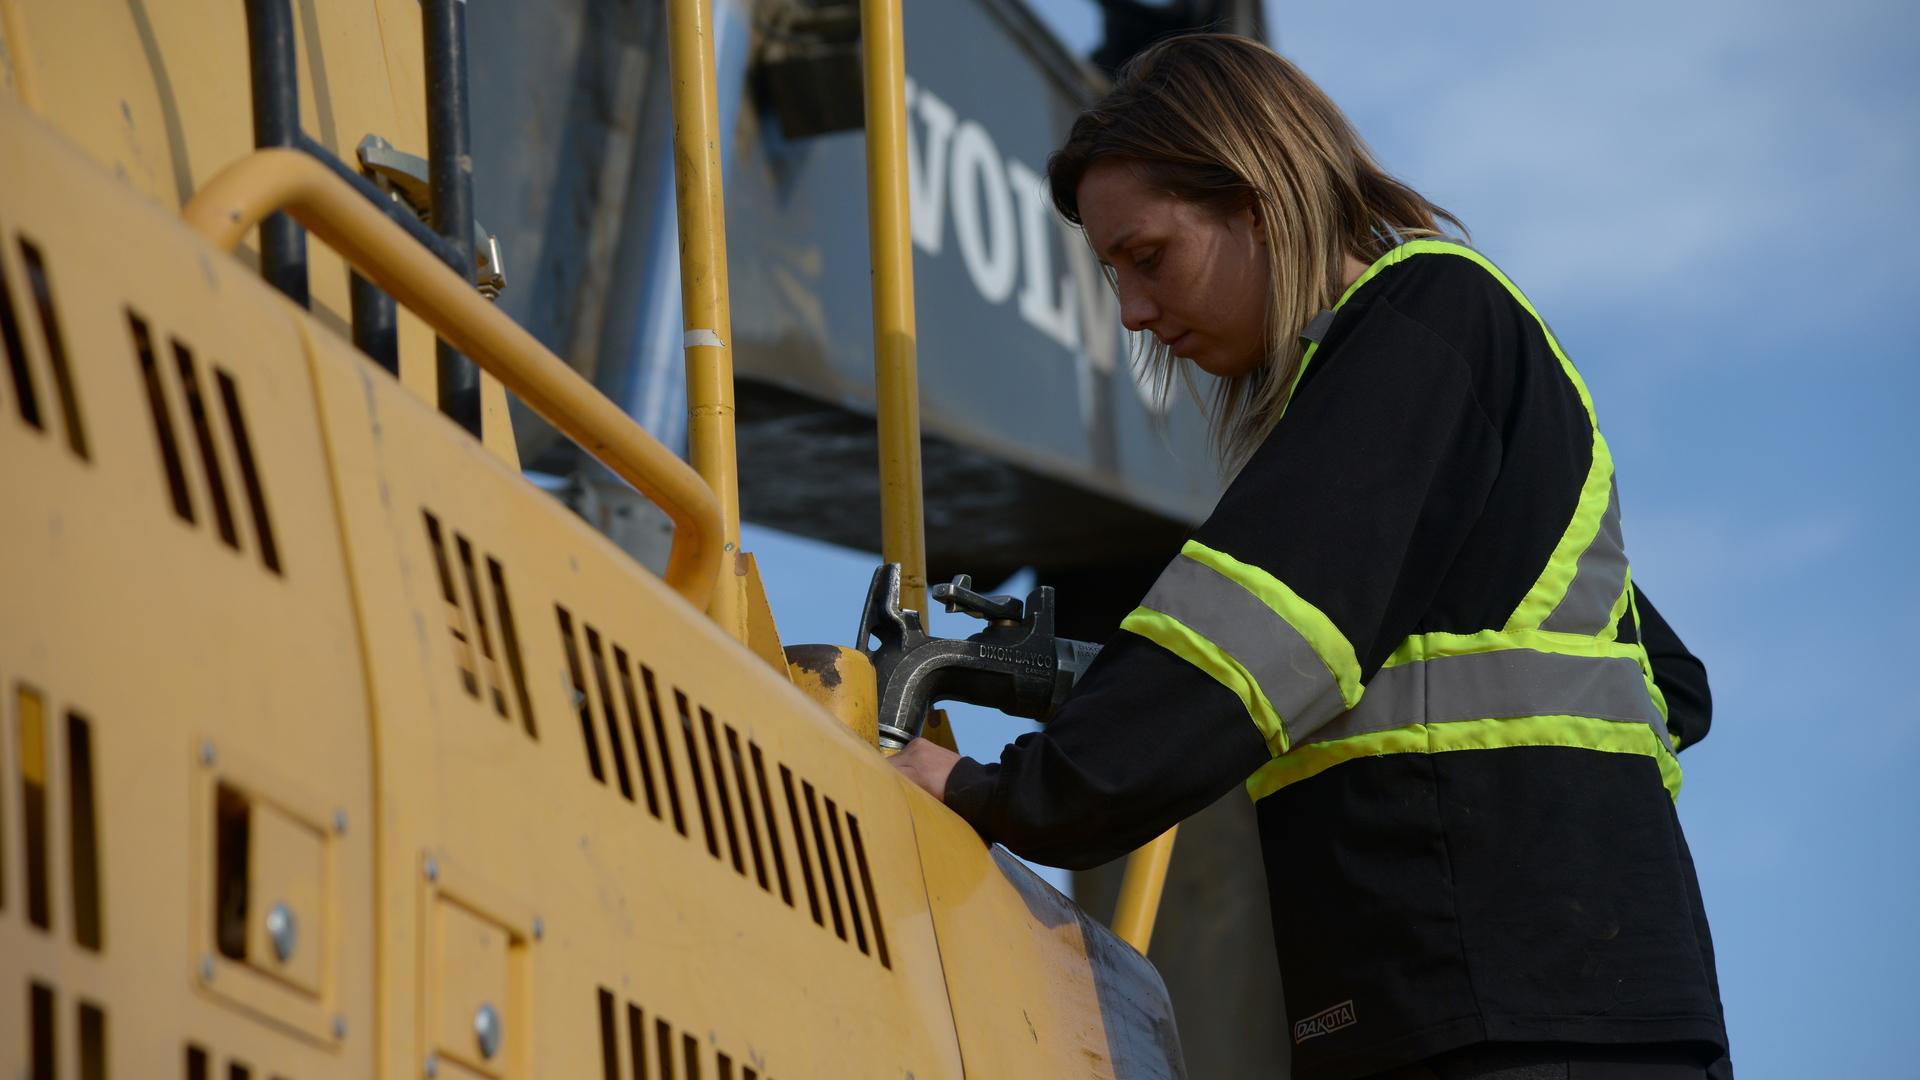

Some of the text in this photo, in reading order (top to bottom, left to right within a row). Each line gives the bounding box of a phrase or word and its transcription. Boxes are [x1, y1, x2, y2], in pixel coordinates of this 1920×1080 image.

[905, 76, 1176, 413] VOLV
[979, 644, 1052, 668] DIXON BAYCO
[1297, 1007, 1352, 1038] DAKOTA
